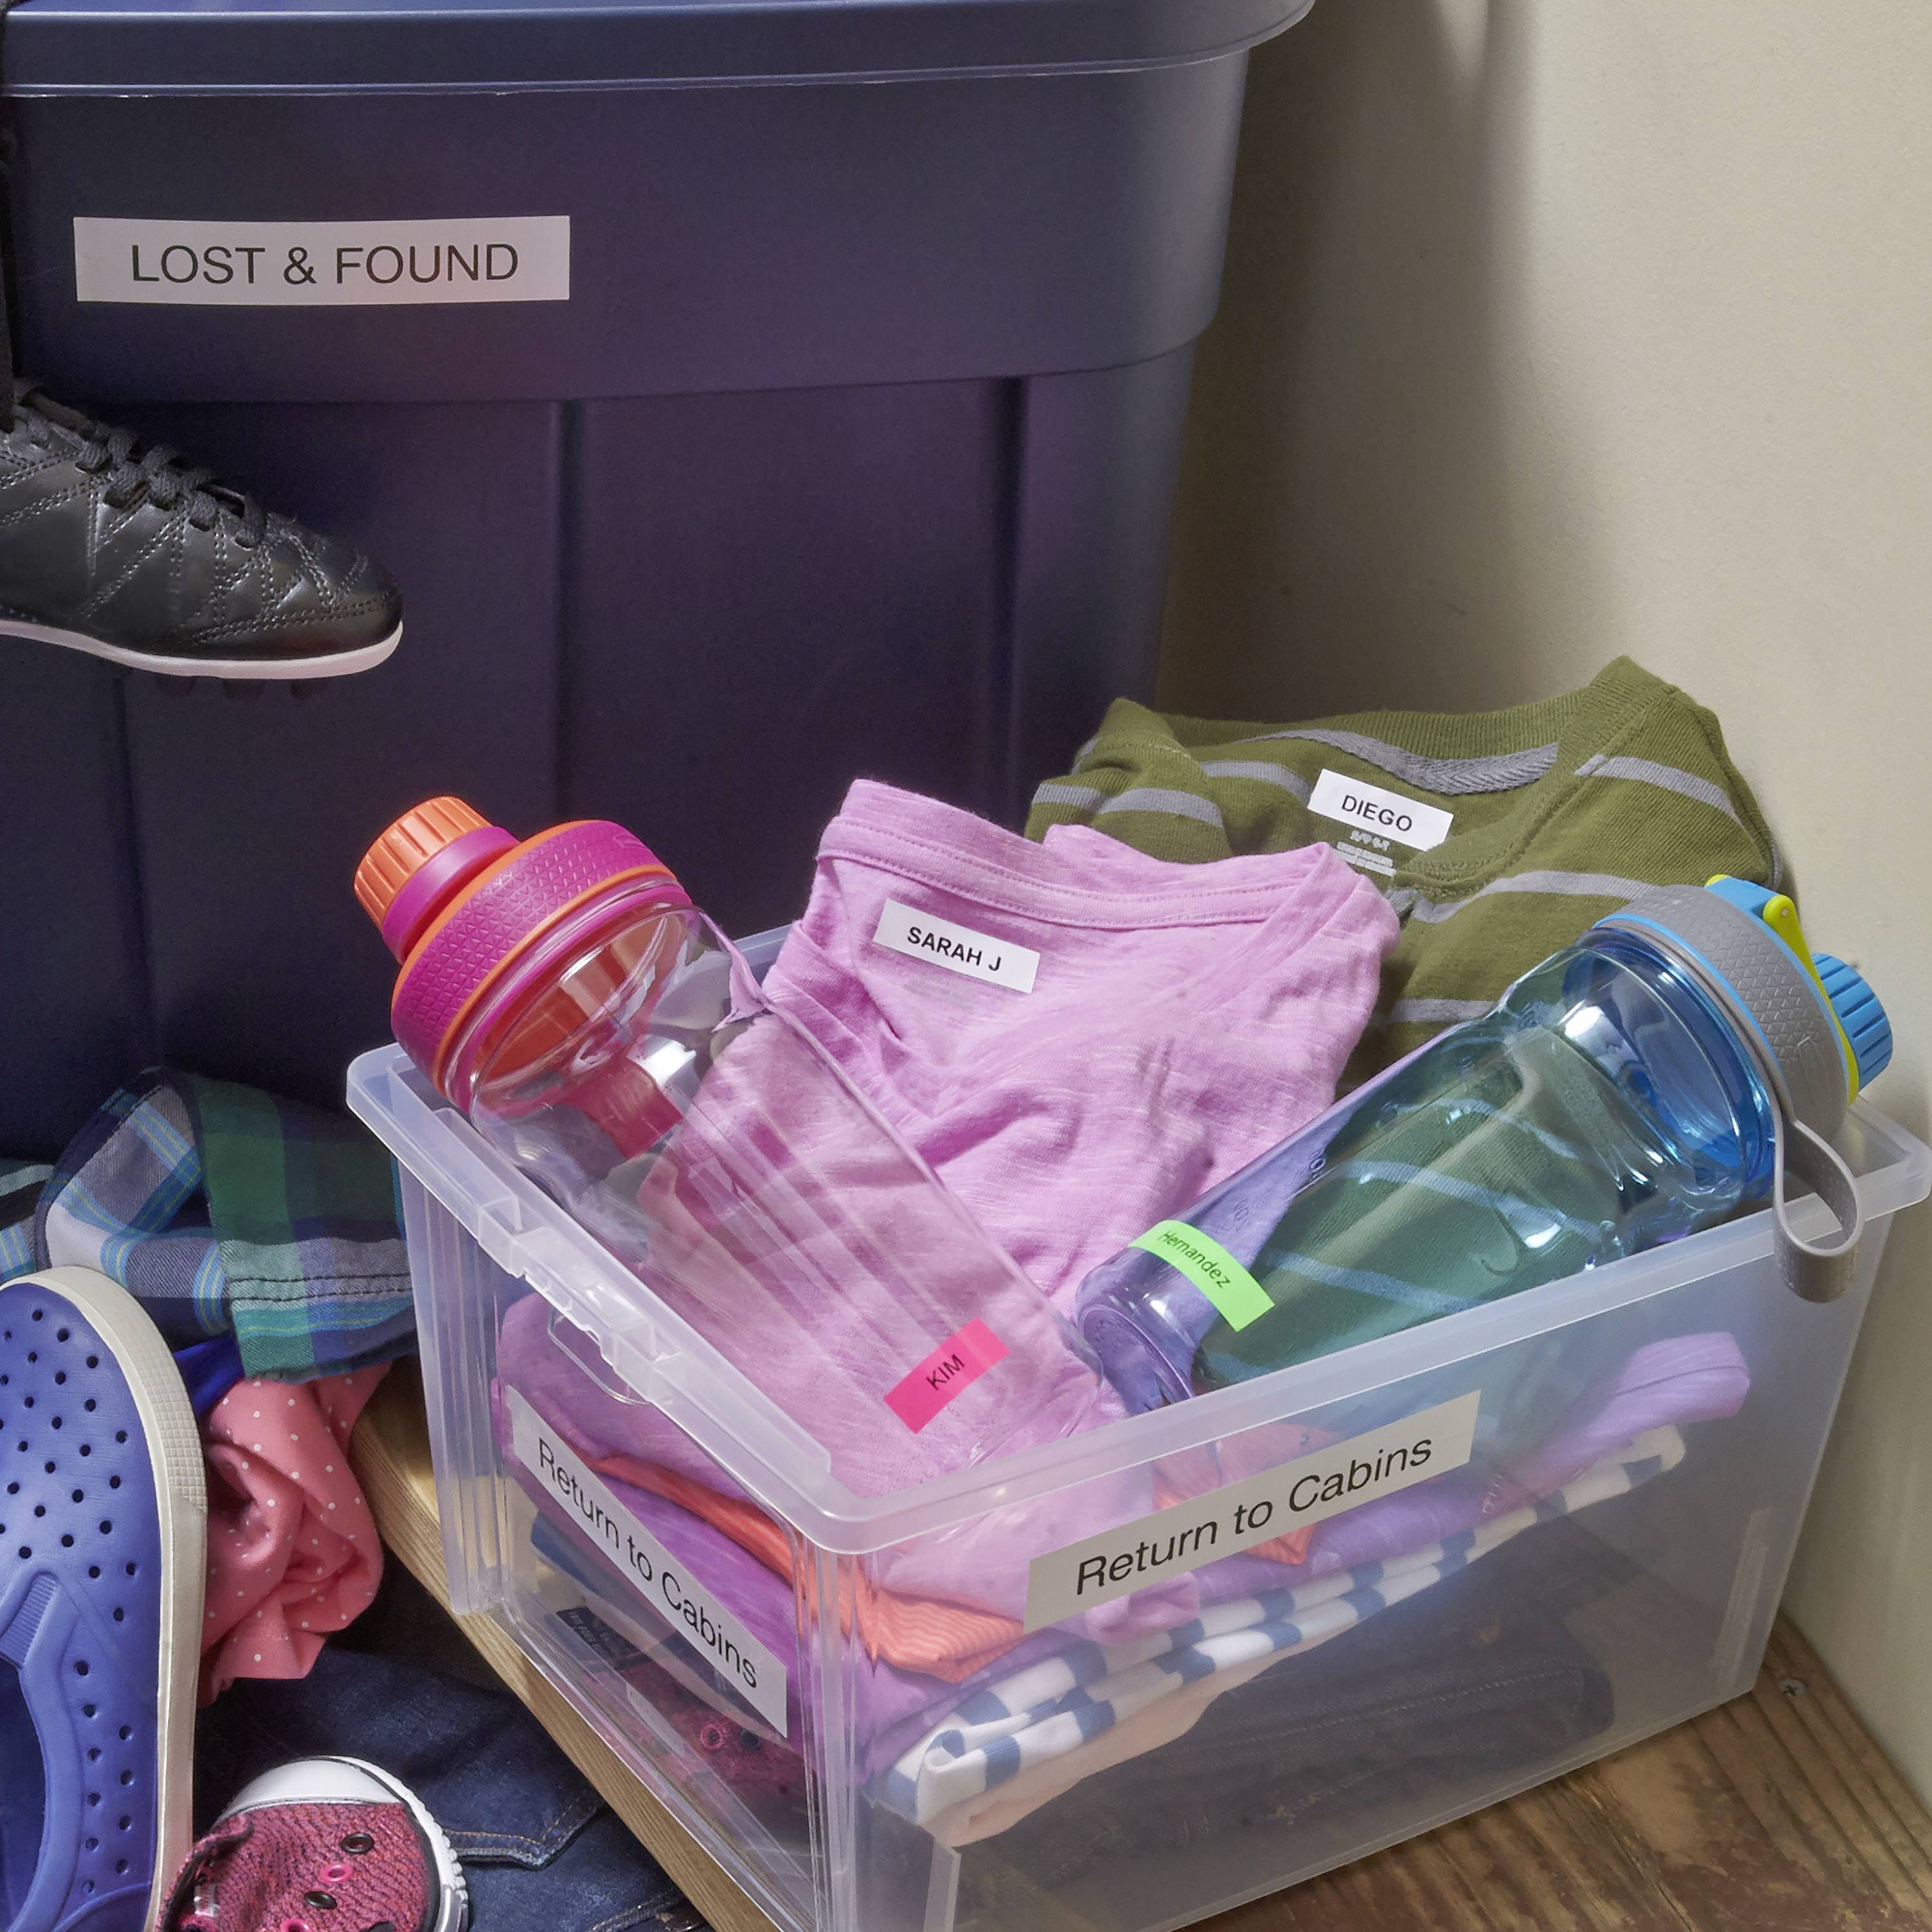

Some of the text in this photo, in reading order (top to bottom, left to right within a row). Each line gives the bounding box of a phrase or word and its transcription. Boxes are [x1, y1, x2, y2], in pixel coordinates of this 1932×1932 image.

[131, 243, 518, 285] LOST & FOUND
[1341, 795, 1413, 831] DIEGO
[907, 926, 1002, 972] SARAH J
[1157, 1231, 1231, 1289] Hernandez
[925, 1354, 965, 1391] KIM
[1076, 1437, 1432, 1595] Return to Cabins
[538, 1437, 620, 1549] Return
[627, 1536, 653, 1581] to
[662, 1571, 758, 1689] Cabins
